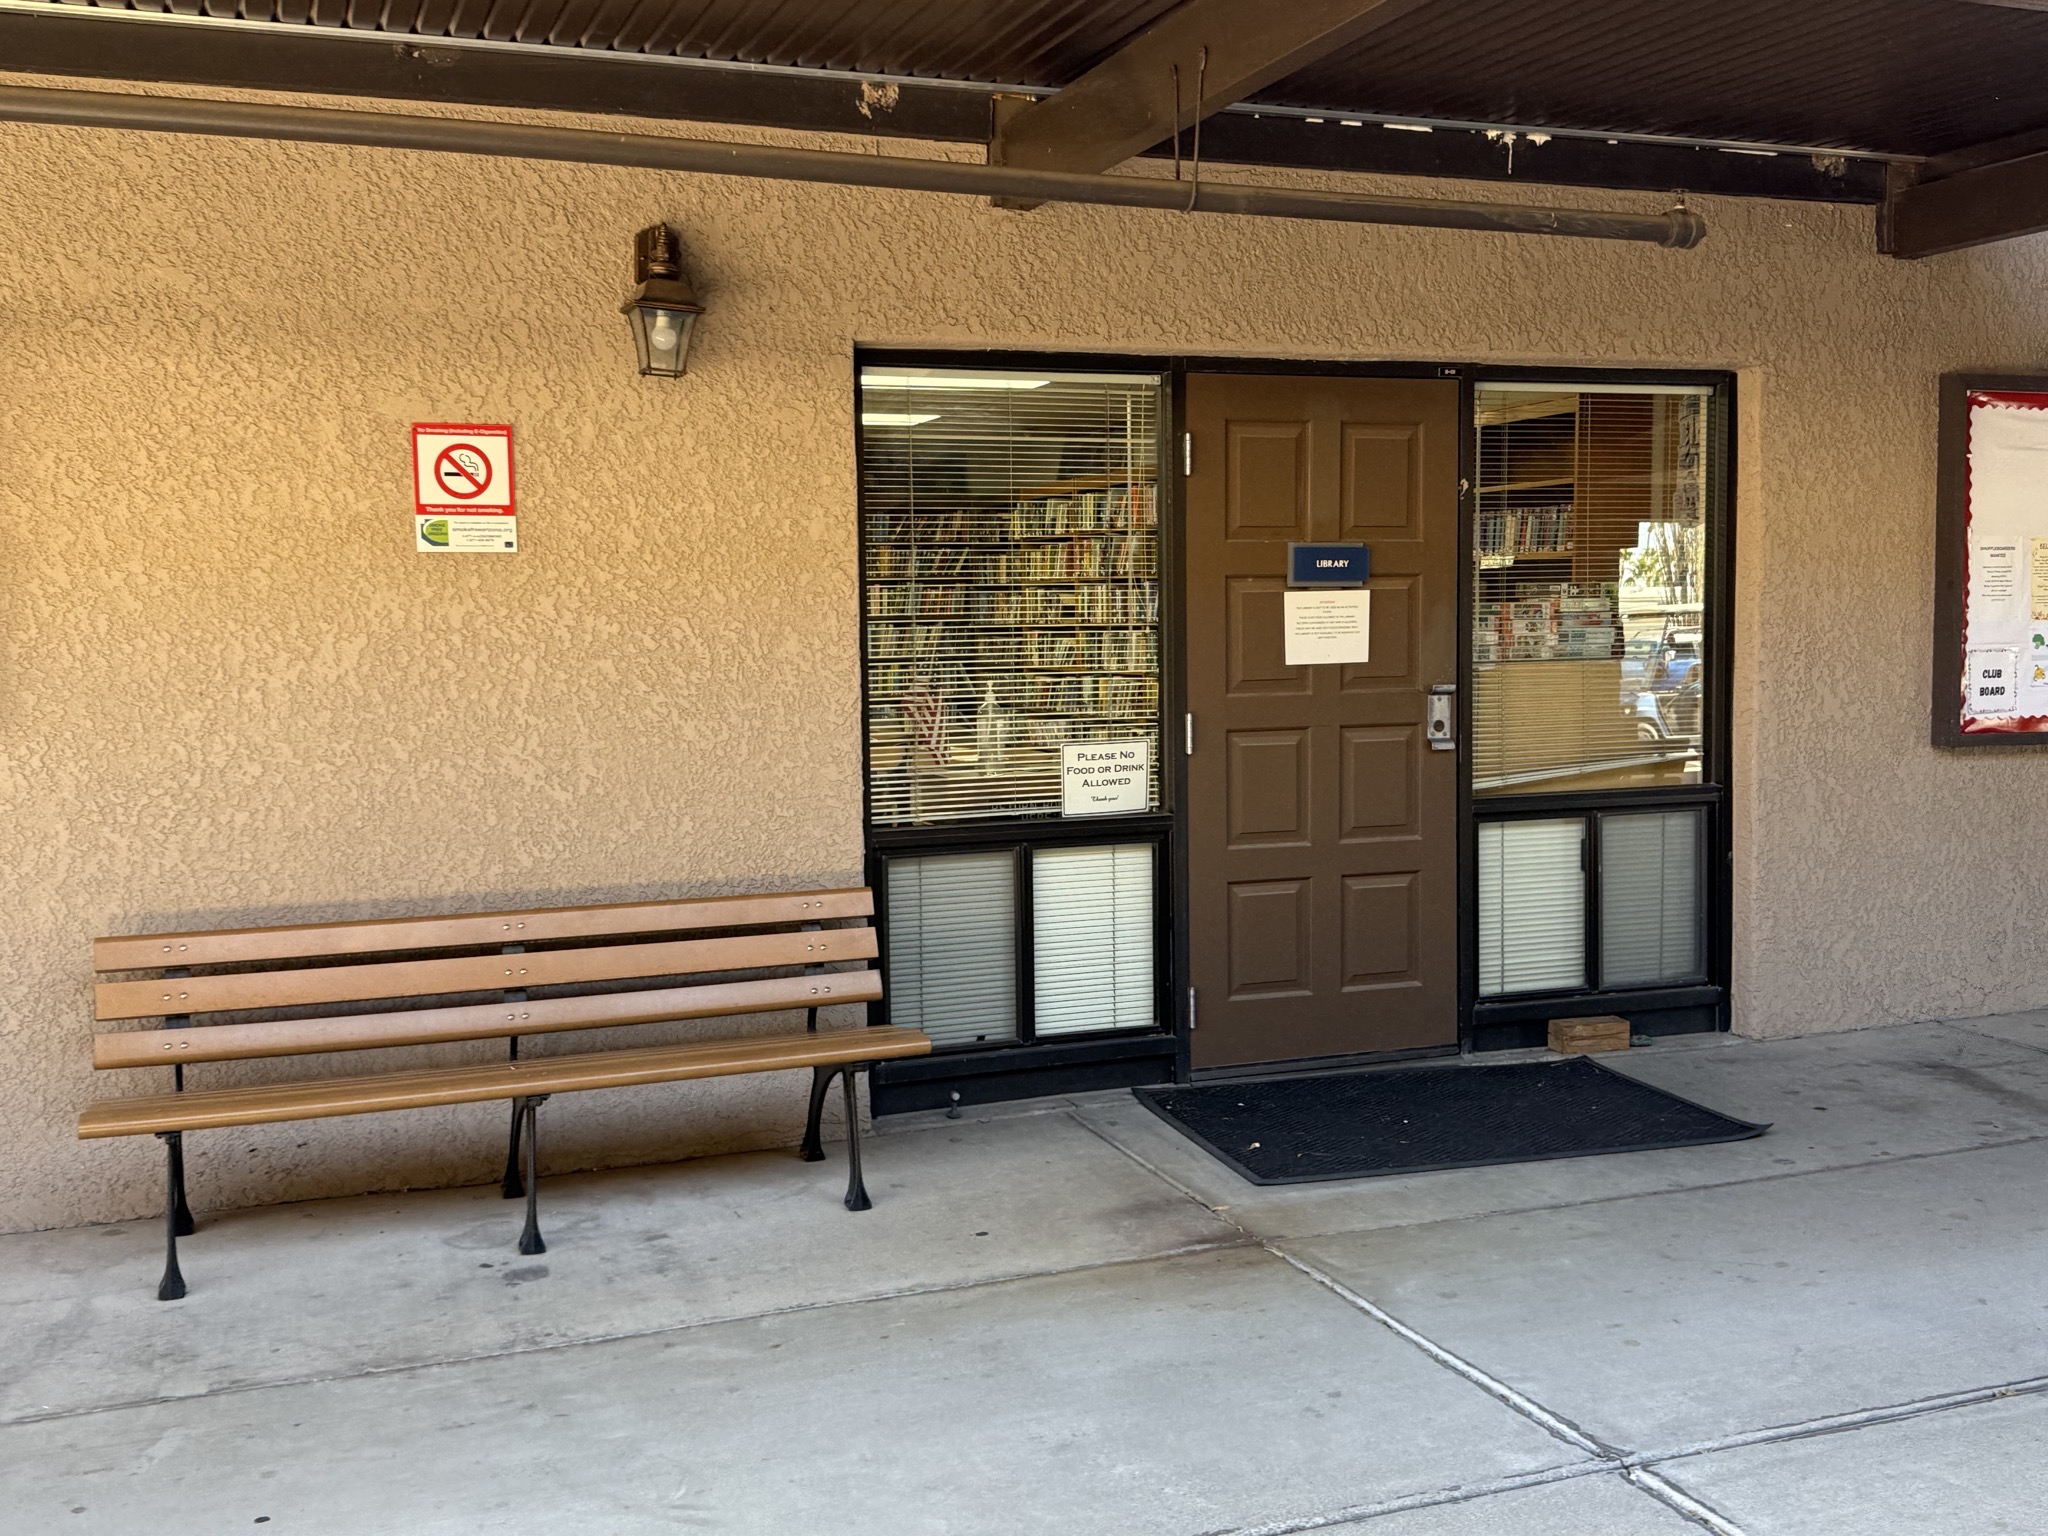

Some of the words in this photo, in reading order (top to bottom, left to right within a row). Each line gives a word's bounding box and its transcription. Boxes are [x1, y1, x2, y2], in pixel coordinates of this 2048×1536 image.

[1316, 559, 1350, 568] LIBRARY
[1982, 669, 2003, 679] CLUB
[1979, 686, 2006, 696] BOARD
[1077, 752, 1117, 762] PLEASE
[1119, 751, 1135, 760] NO
[1066, 766, 1095, 775] FOOD
[1097, 766, 1112, 774] OR
[1114, 764, 1145, 773] DRINK
[1081, 778, 1131, 788] ALLOWED
[1108, 795, 1119, 803] you!
